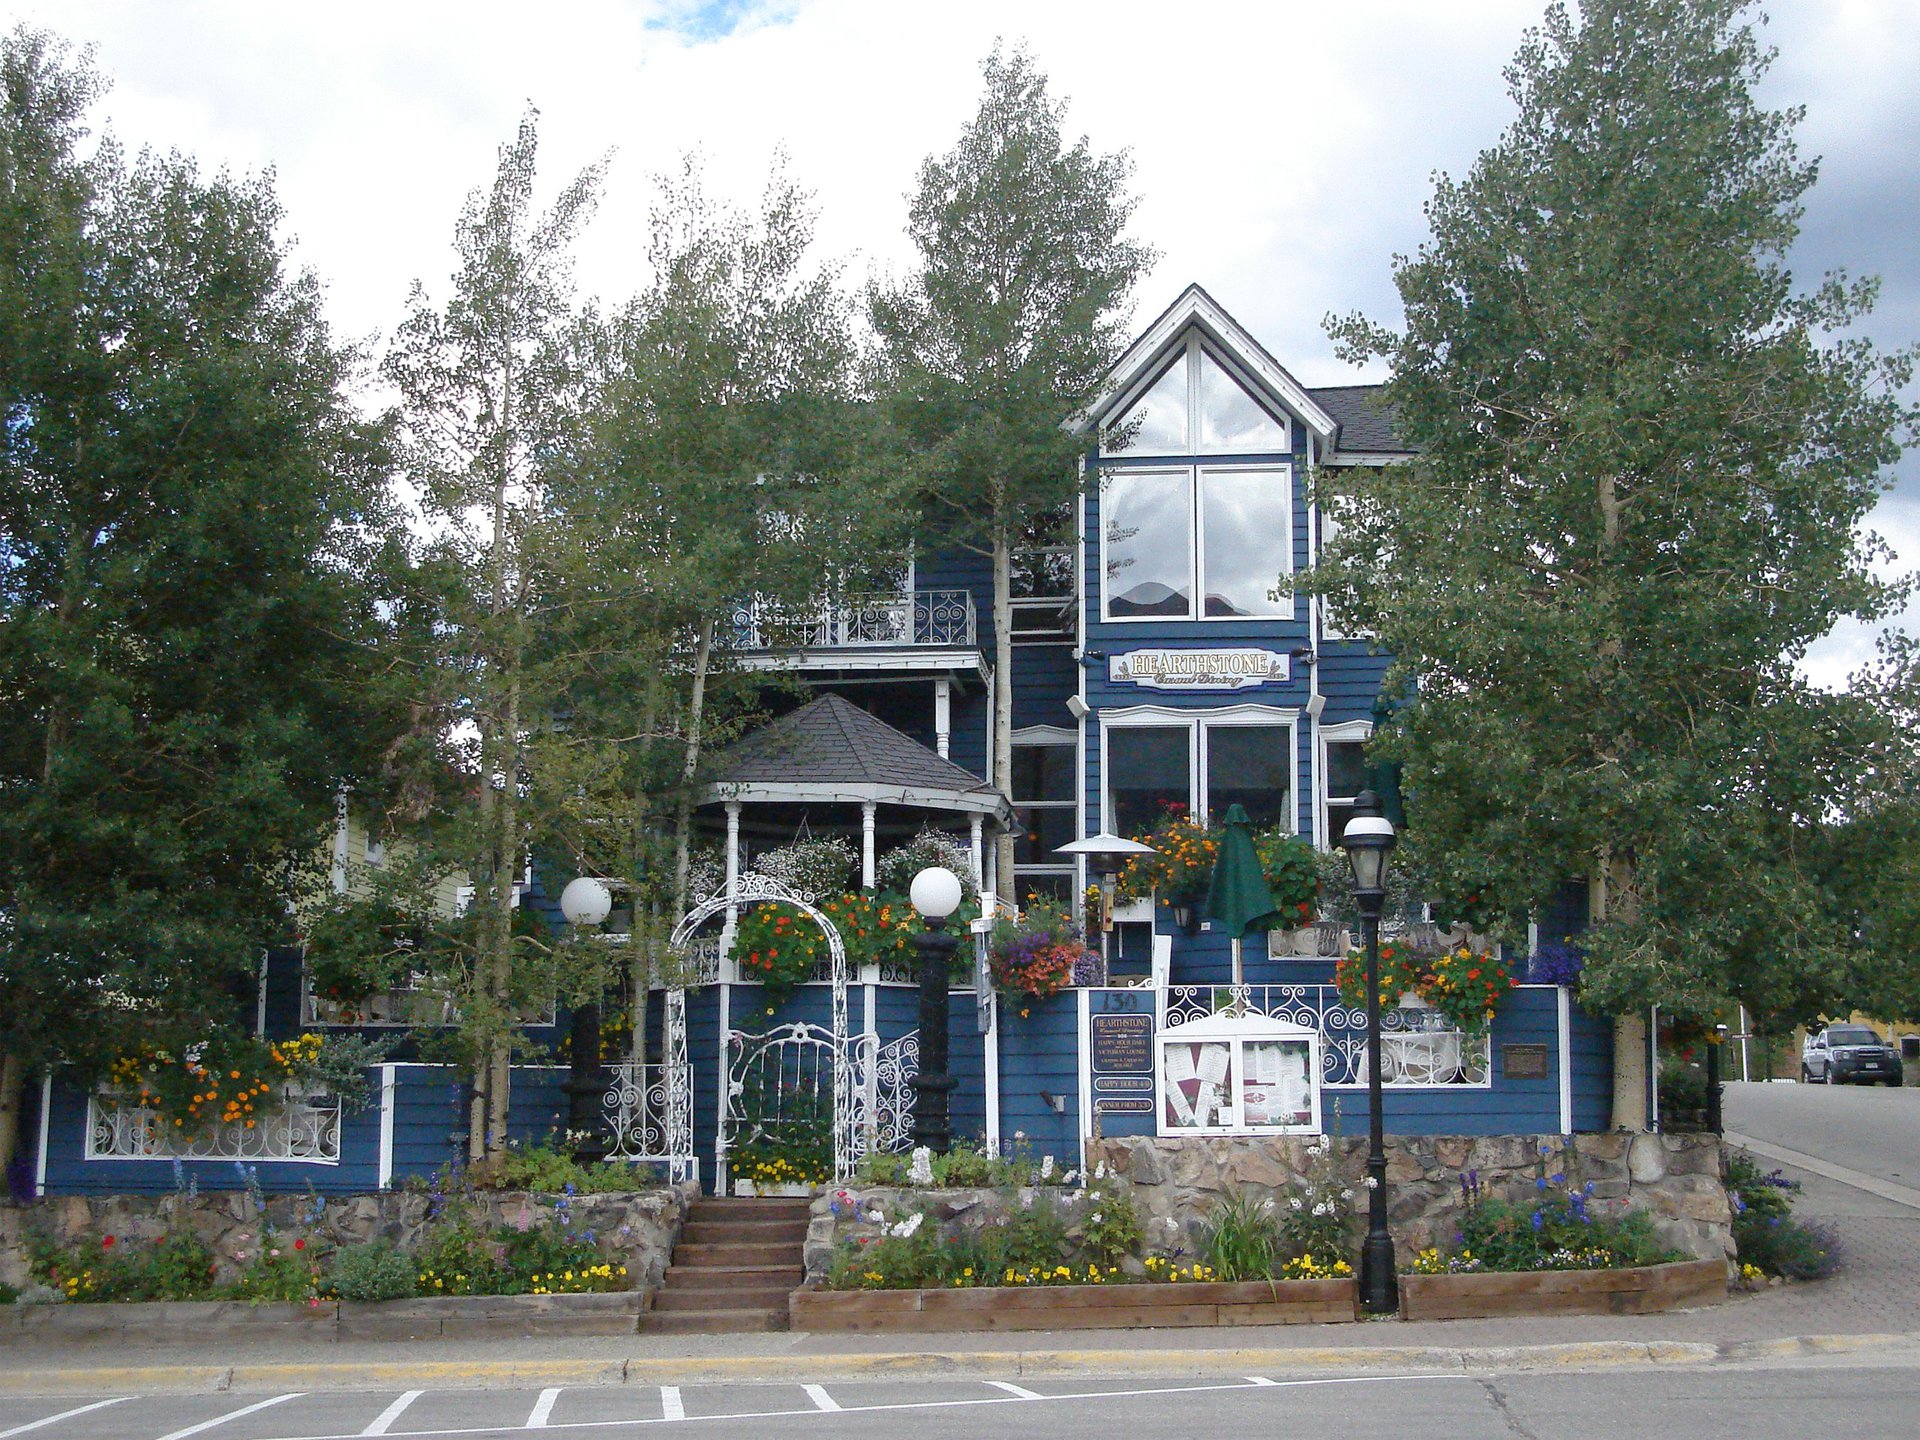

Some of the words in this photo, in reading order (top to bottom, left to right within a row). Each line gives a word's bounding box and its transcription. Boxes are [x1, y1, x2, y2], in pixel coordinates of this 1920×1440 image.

[1132, 653, 1268, 674] HEARTHSTONE
[1154, 673, 1196, 684] Casual
[1198, 674, 1243, 687] Dining
[1103, 992, 1137, 1011] 130
[1096, 1018, 1148, 1027] HEARTHSTONE
[1098, 1080, 1118, 1088] HAPPY
